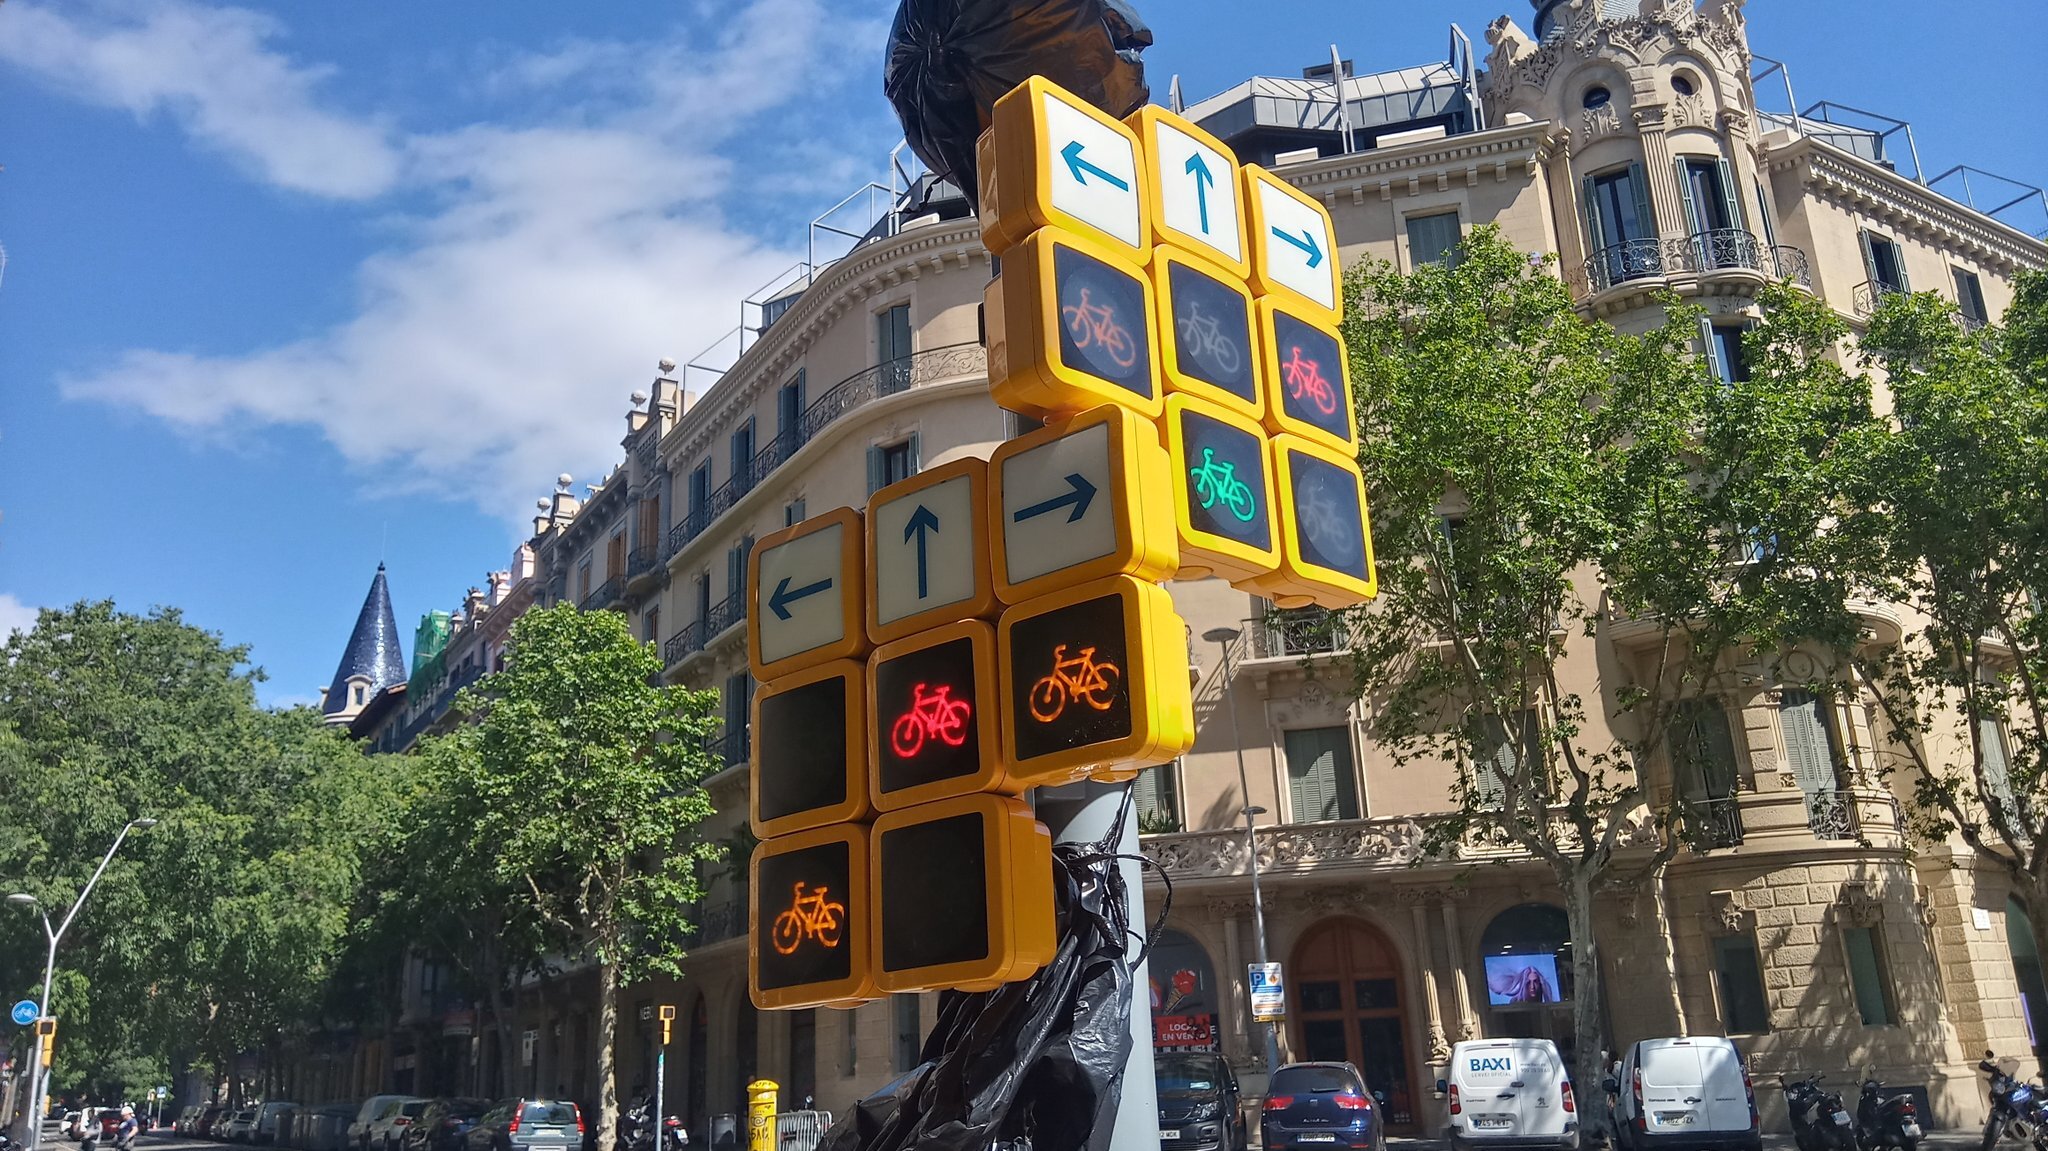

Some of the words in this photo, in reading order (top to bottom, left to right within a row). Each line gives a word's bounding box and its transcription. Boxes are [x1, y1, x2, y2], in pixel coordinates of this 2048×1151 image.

[1253, 973, 1262, 985] P
[1162, 1033, 1173, 1041] EN
[1176, 1032, 1206, 1040] VENA
[1470, 1057, 1511, 1071] BAXI
